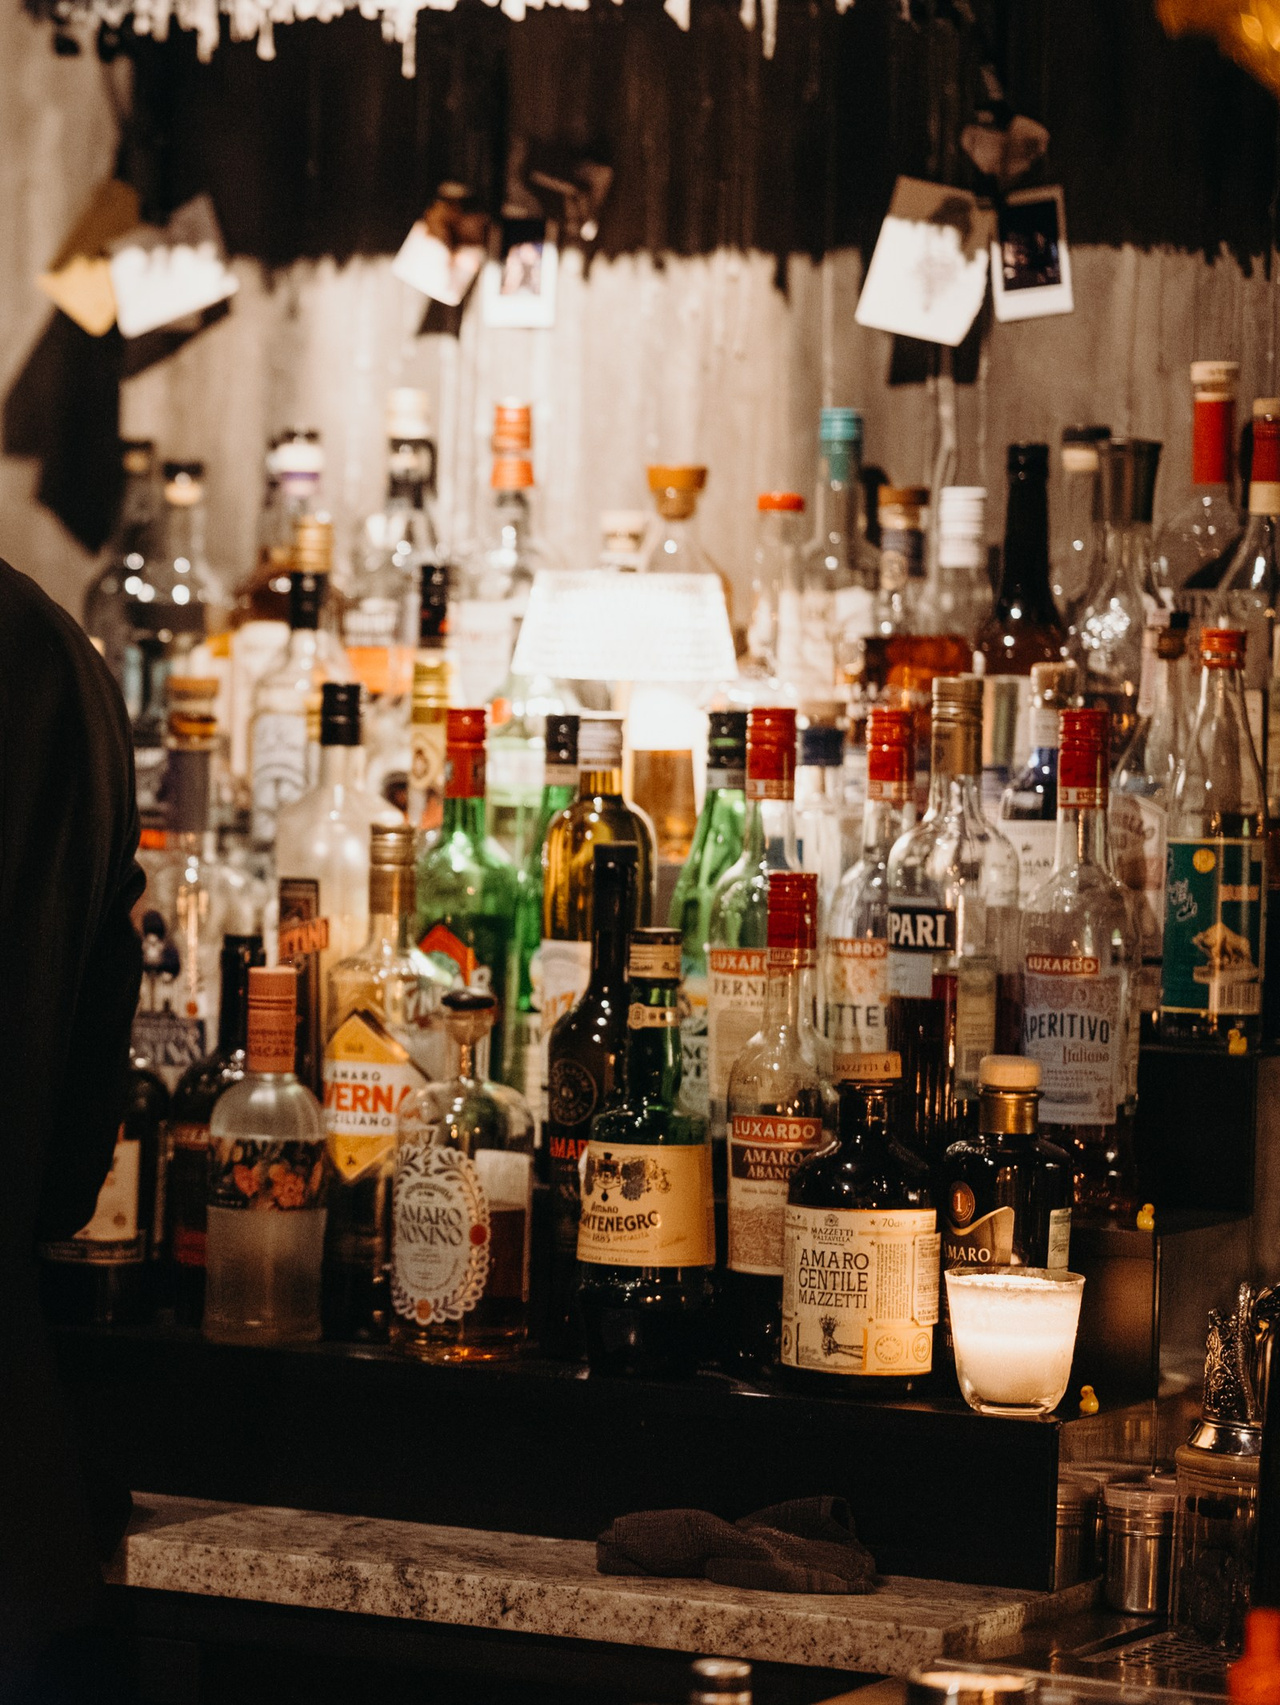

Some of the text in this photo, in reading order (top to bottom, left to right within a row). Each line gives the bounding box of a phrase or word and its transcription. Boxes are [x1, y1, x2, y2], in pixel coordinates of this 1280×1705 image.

[887, 911, 947, 947] PARI
[1028, 957, 1097, 972] LUXARDO
[332, 1070, 382, 1081] AMARO
[735, 1120, 816, 1140] LUXARDO
[743, 1148, 804, 1166] AMARO
[401, 1203, 463, 1227] AMARO
[400, 1224, 464, 1247] NONINO
[811, 1227, 854, 1237] MAZZETTI
[800, 1248, 869, 1270] AMARO
[799, 1268, 869, 1293] GENTILE
[798, 1289, 868, 1309] MAZZETTI
